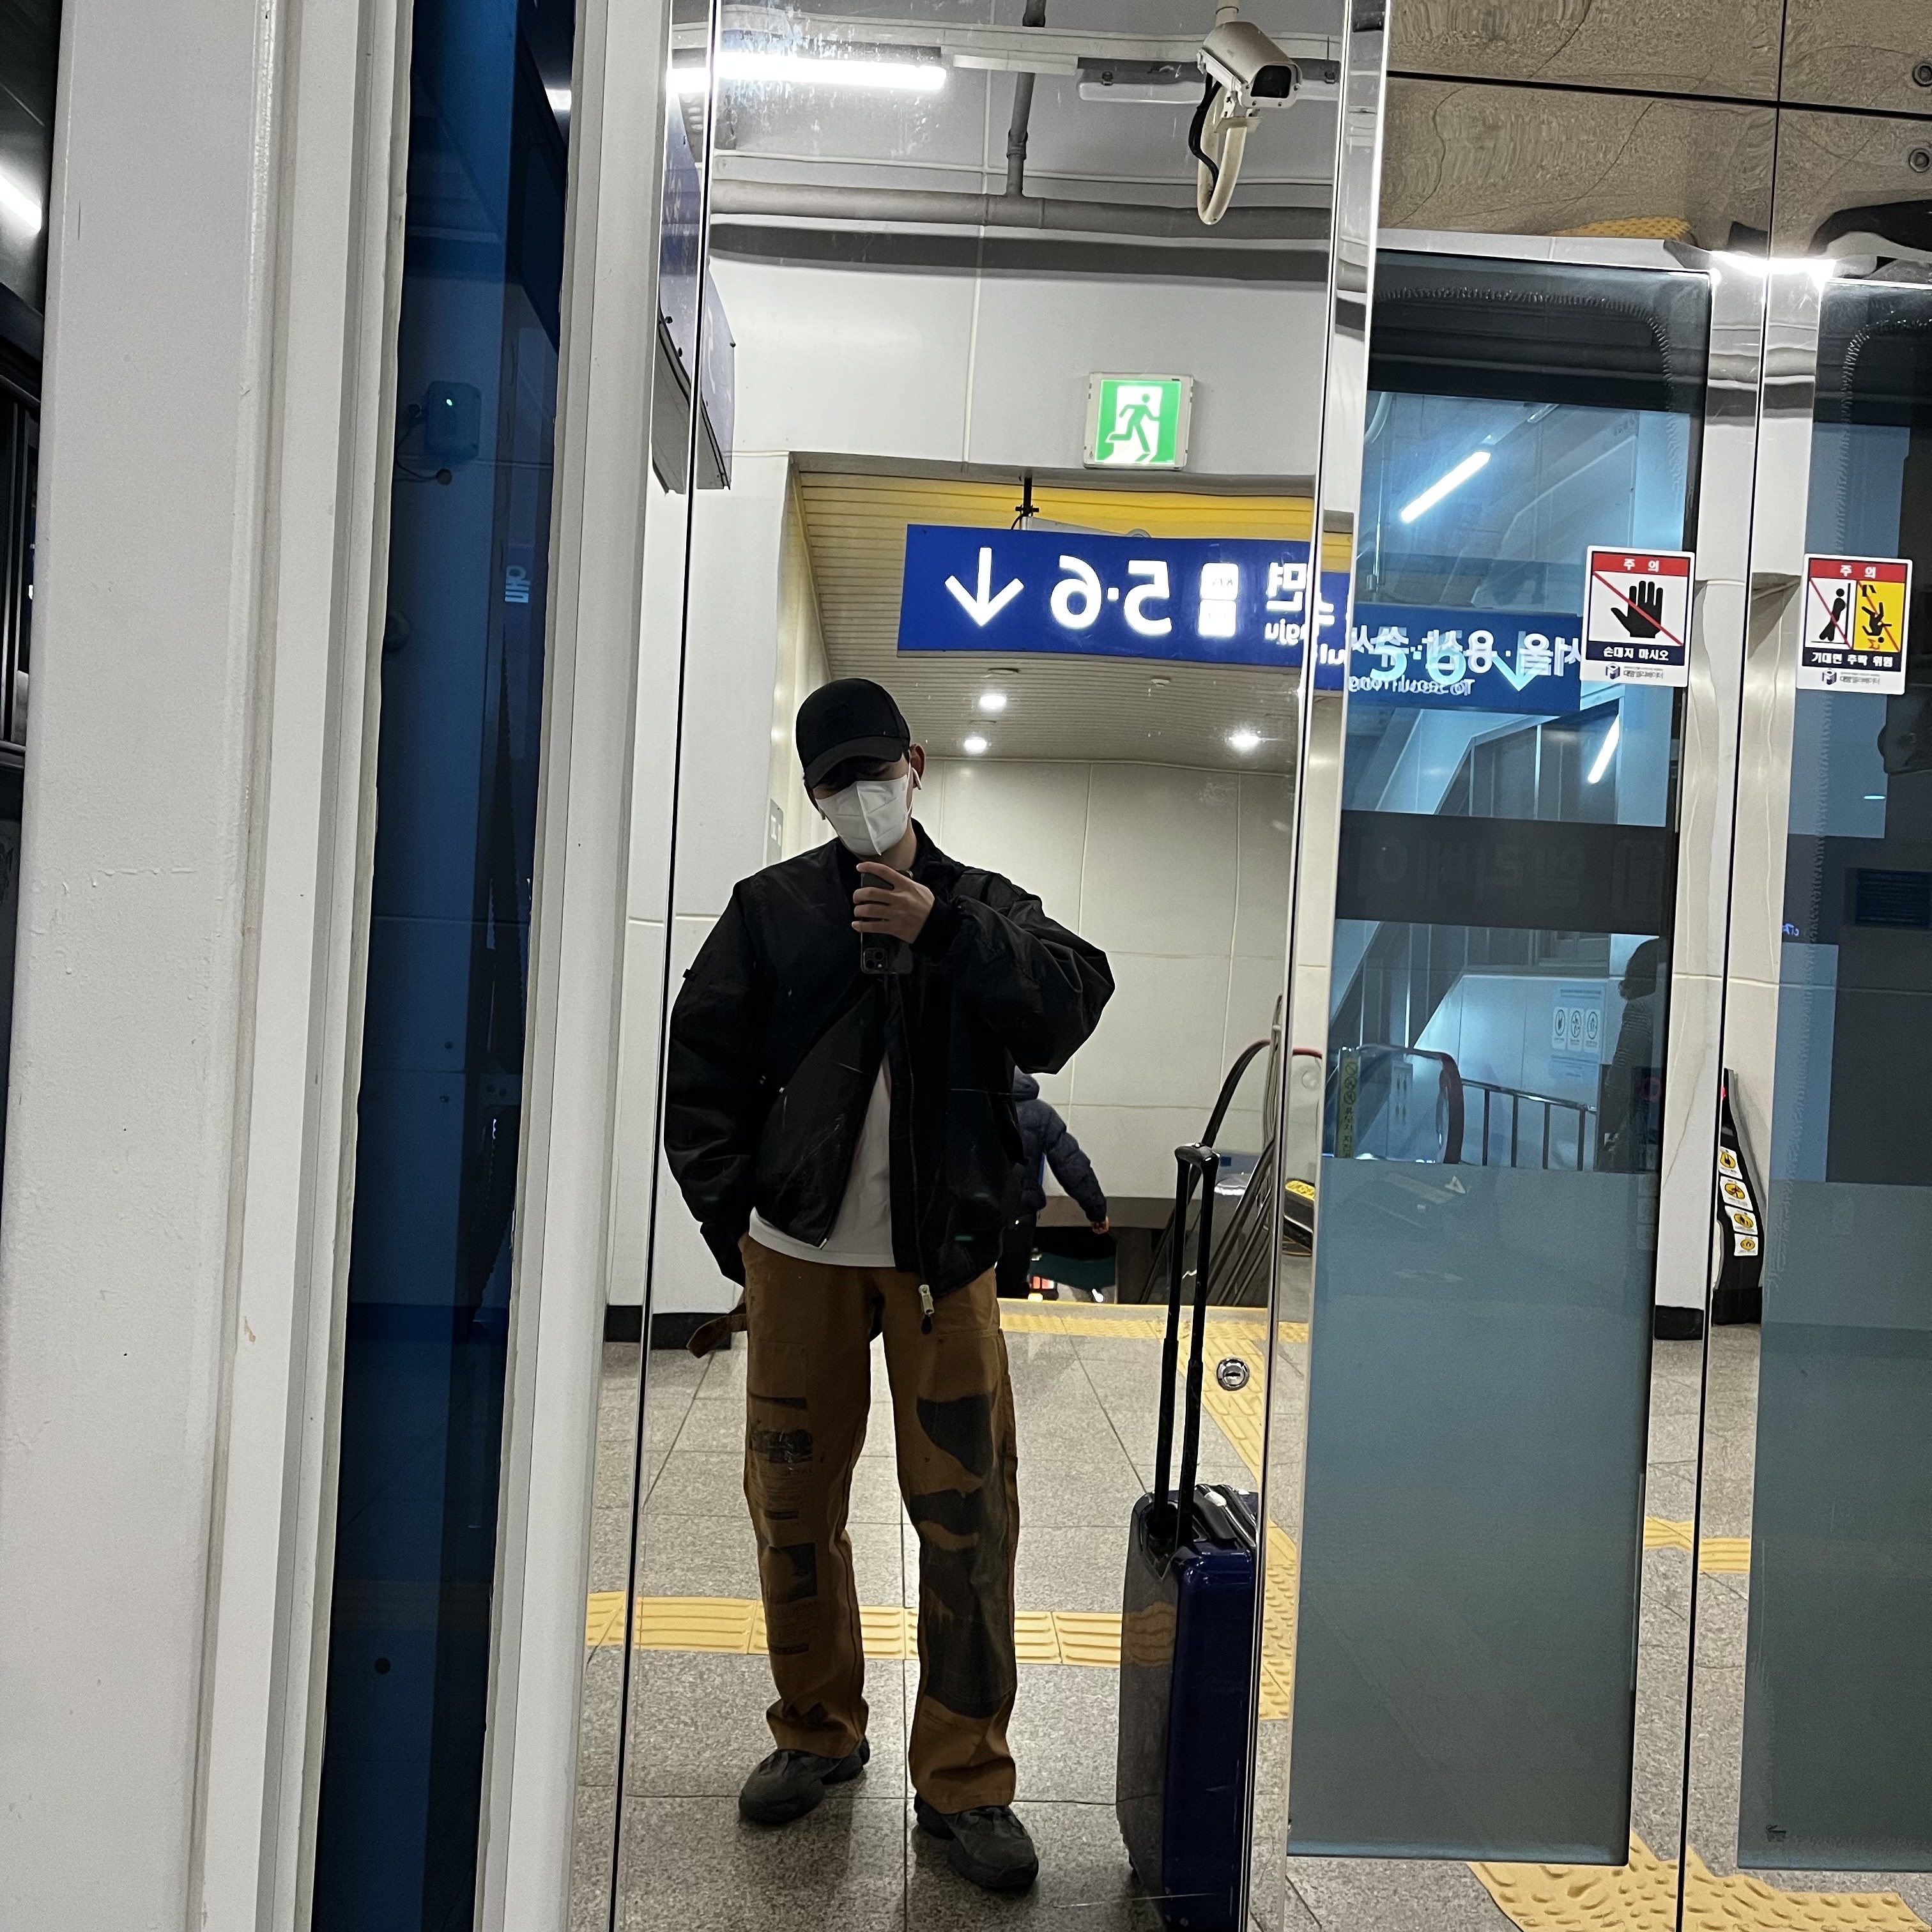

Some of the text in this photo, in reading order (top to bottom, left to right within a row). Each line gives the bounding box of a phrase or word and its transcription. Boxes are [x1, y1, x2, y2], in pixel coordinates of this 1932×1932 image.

[1603, 646, 1669, 661] 손대지 마시오
[1812, 652, 1893, 668] 기대면 추락 위험
